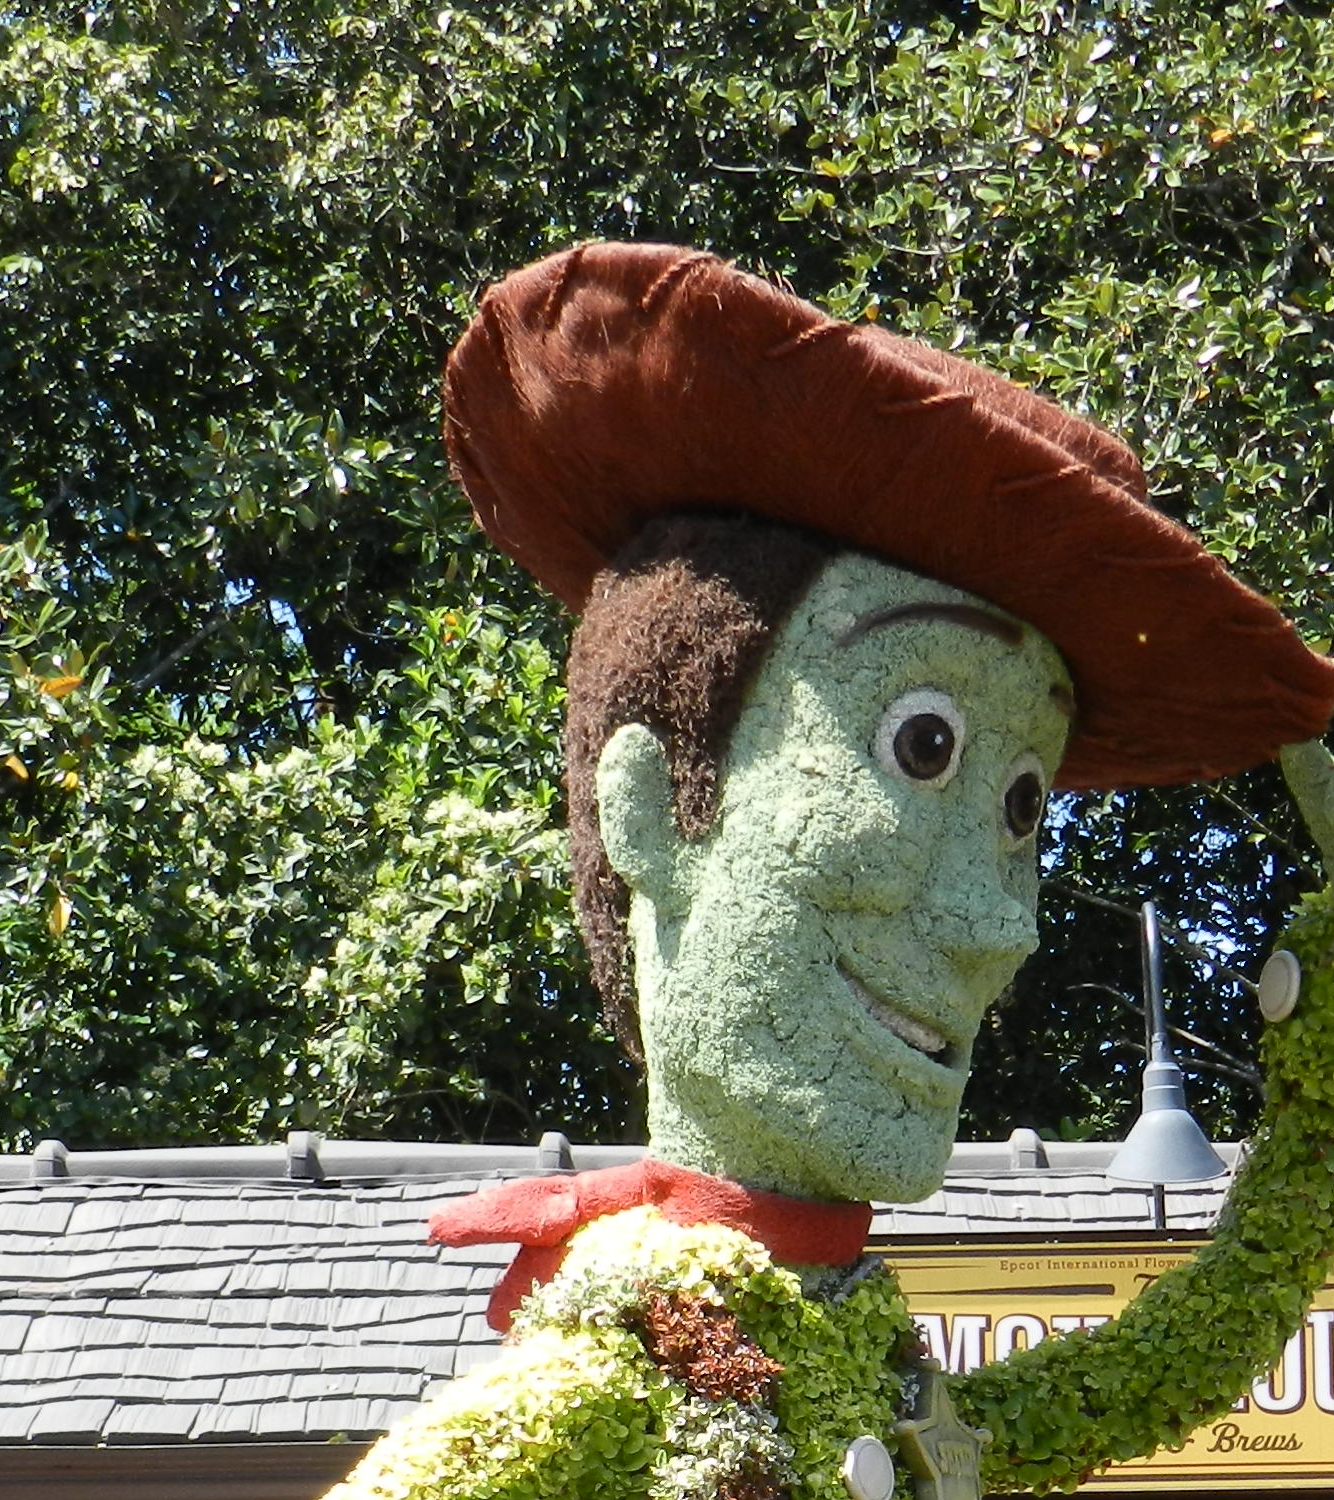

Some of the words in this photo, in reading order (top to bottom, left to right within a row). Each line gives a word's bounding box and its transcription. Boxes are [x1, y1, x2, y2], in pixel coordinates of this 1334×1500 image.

[1046, 1257, 1139, 1270] International
[1144, 1256, 1191, 1270] Flow
[1206, 1422, 1304, 1453] Brews
